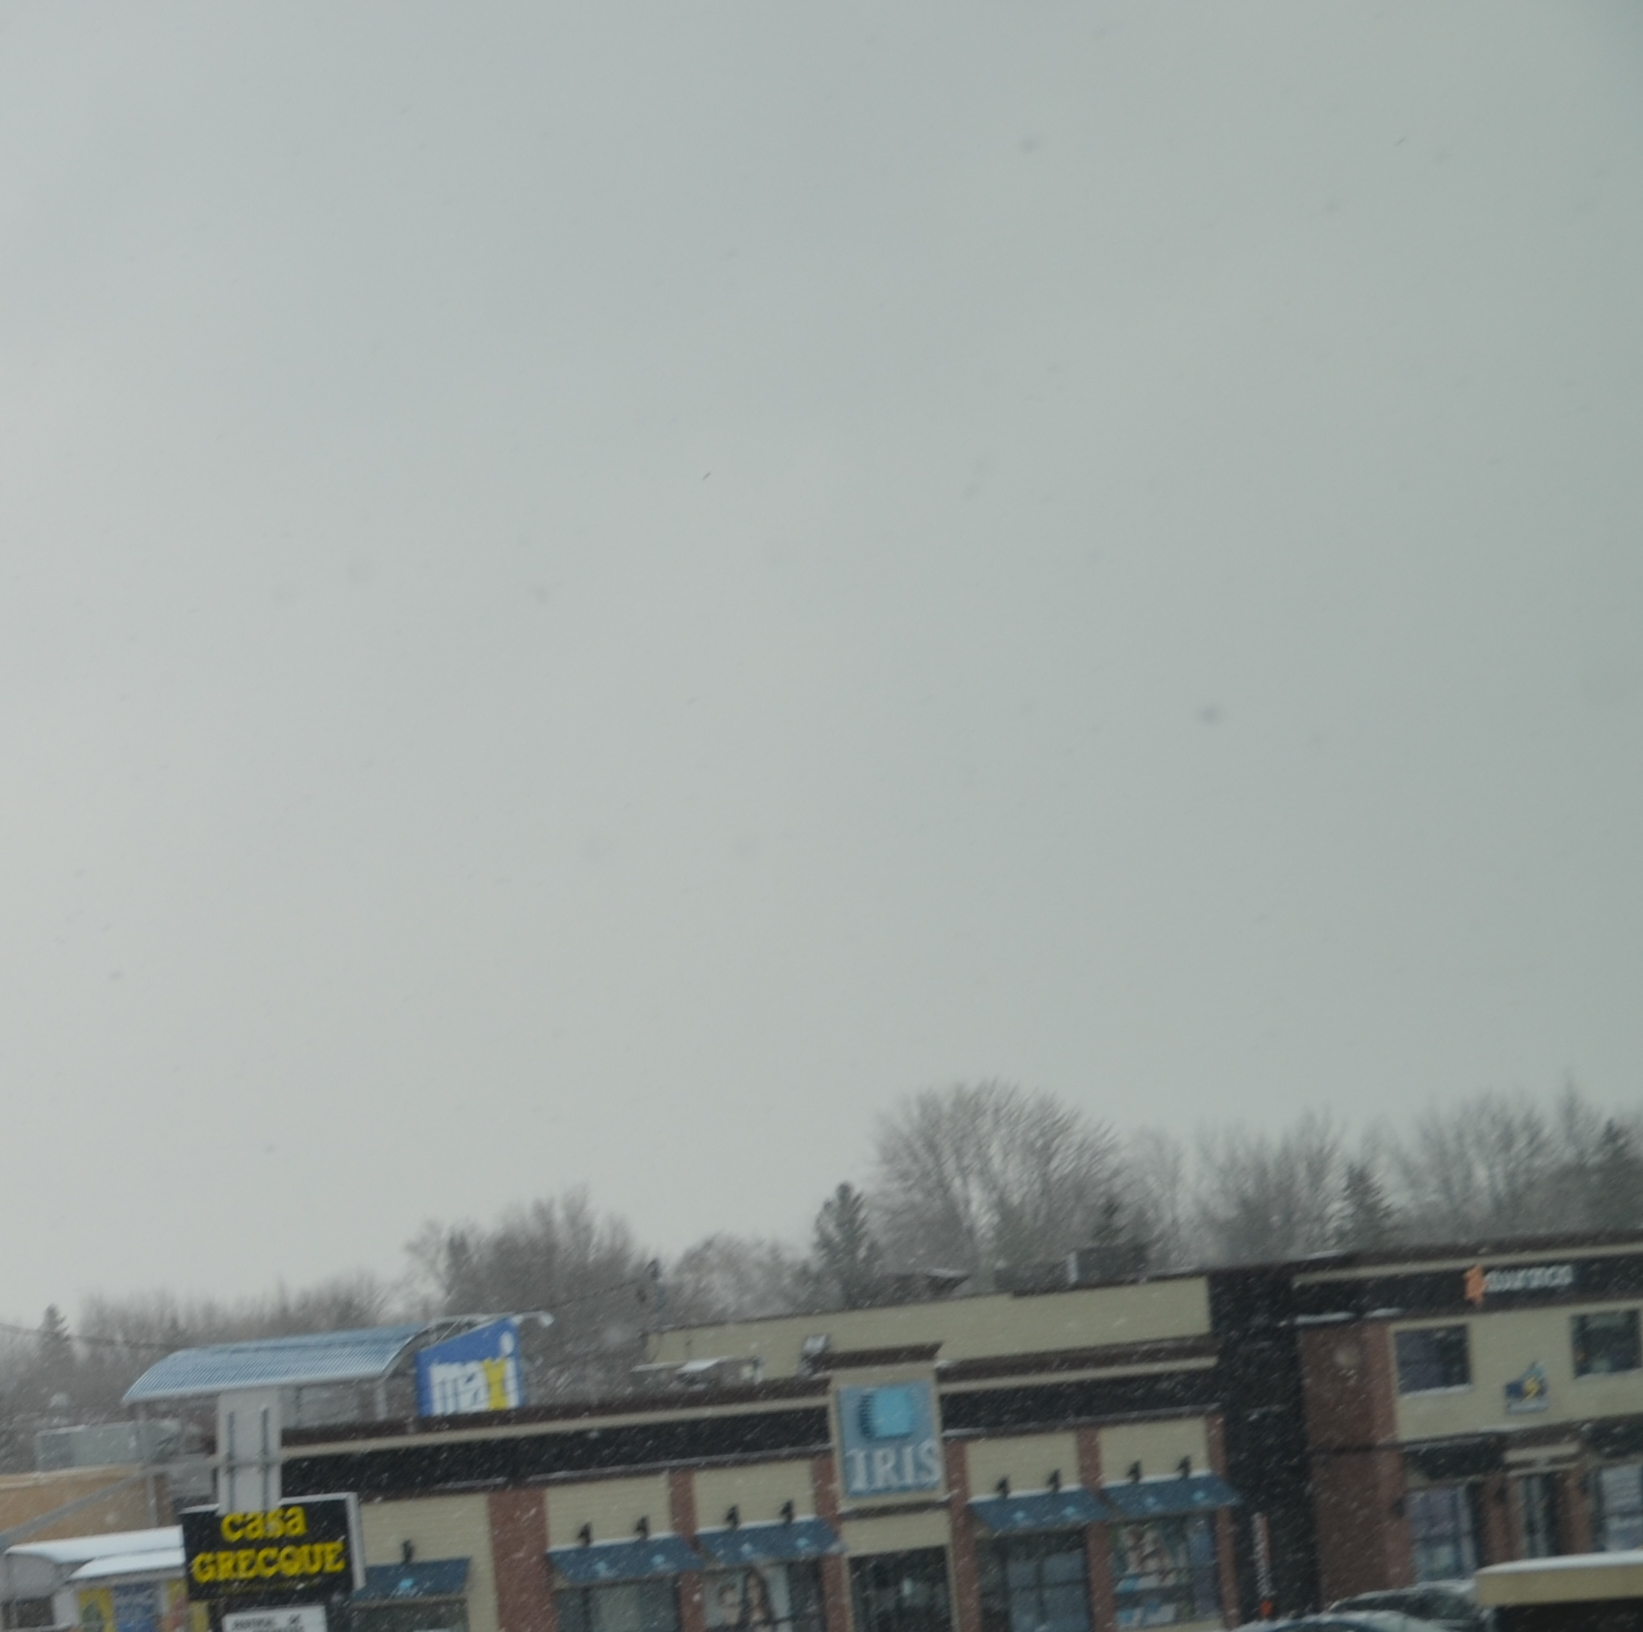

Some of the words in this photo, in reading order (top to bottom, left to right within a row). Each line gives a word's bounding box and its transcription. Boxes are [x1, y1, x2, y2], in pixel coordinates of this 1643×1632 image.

[428, 1330, 521, 1416] maxi
[844, 1440, 944, 1493] IRIS
[190, 1541, 347, 1584] GRECQUE
